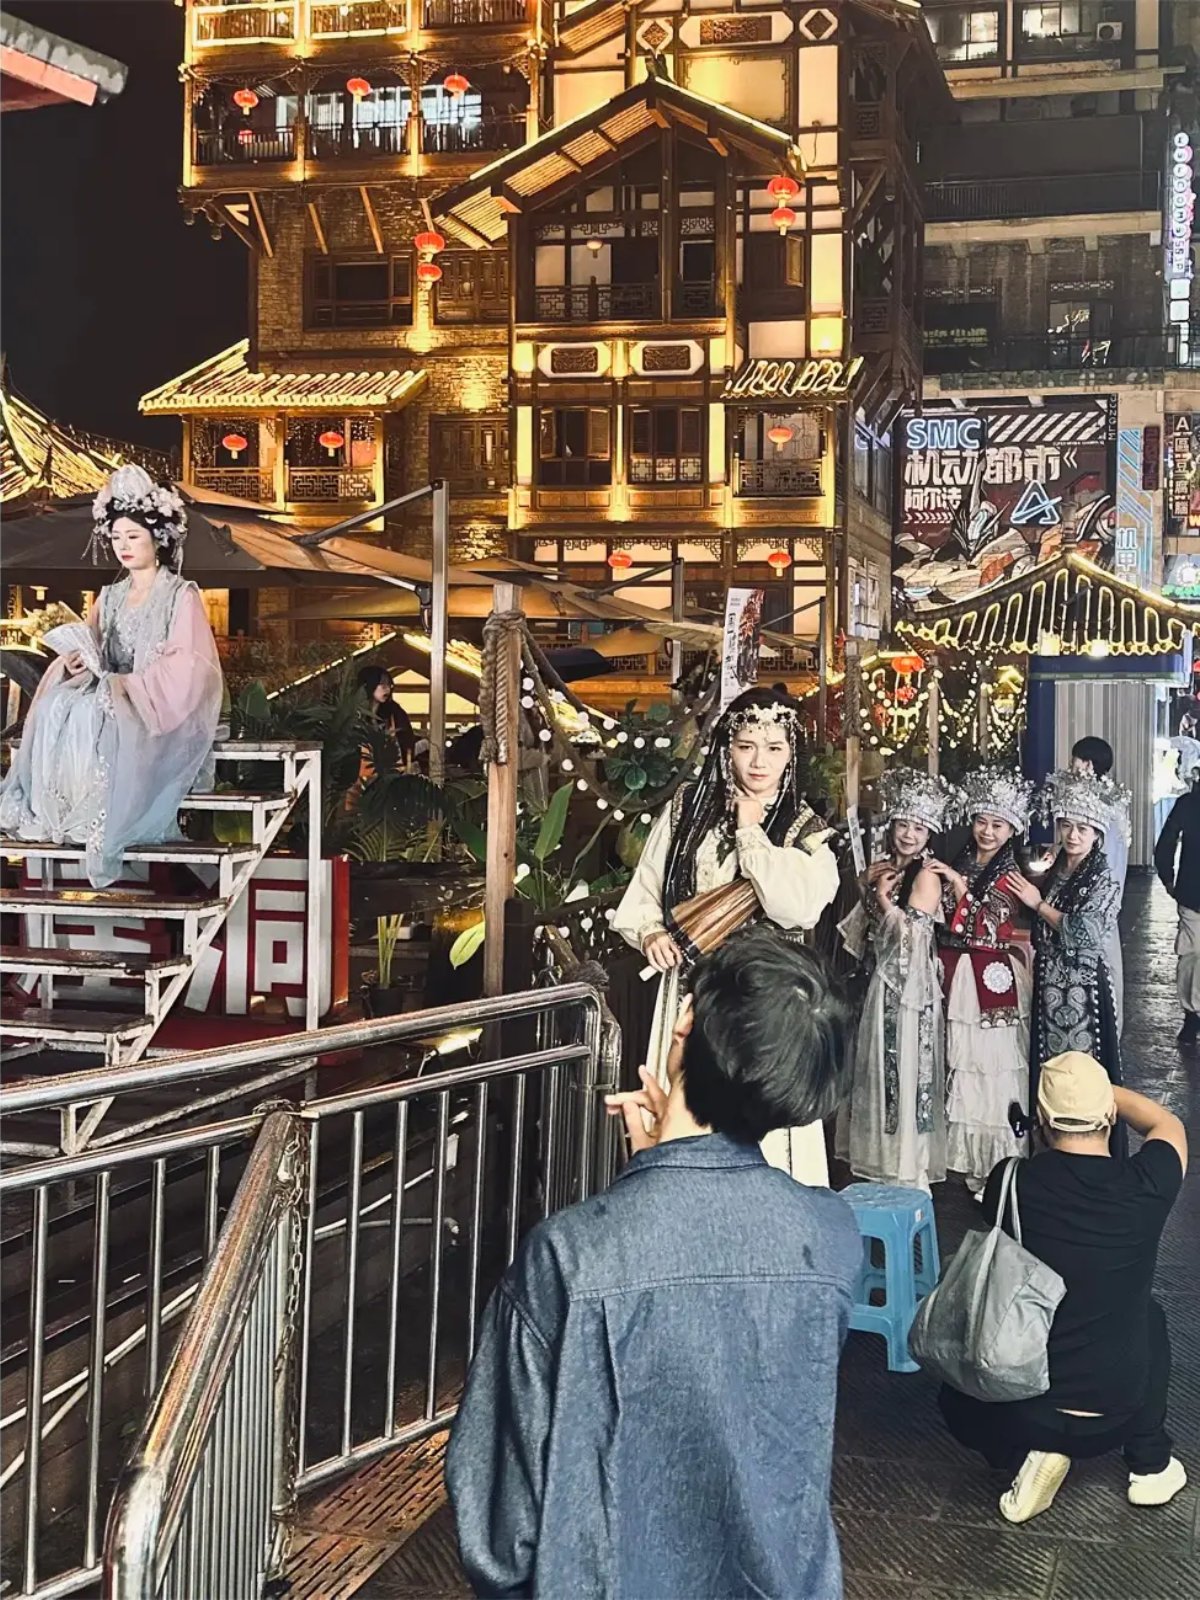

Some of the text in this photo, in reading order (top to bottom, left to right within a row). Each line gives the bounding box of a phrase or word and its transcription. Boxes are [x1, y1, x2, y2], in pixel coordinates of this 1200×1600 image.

[906, 418, 981, 449] SMC
[904, 445, 1061, 485] 机动都市
[904, 486, 962, 512] 阿尔法
